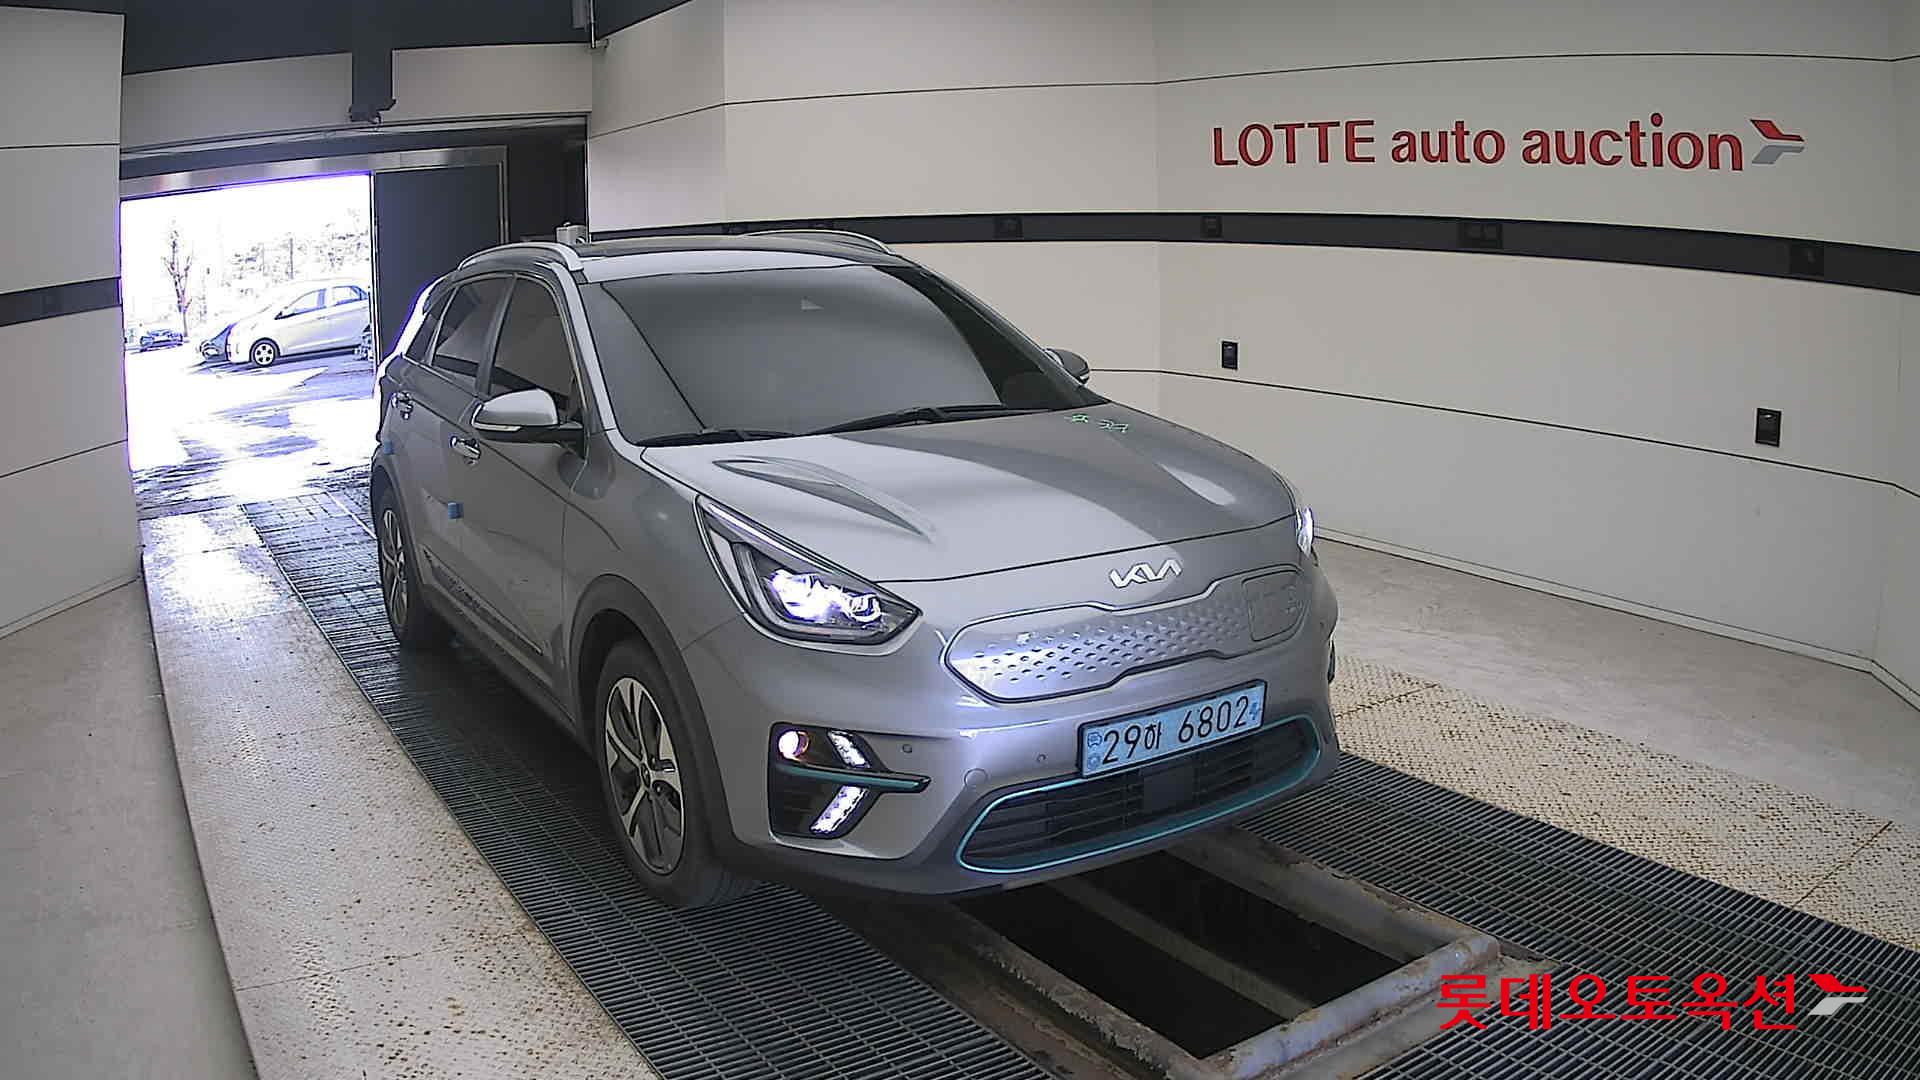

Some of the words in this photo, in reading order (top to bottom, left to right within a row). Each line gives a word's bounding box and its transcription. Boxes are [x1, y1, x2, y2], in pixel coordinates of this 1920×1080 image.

[1212, 119, 1376, 167] LOTTE
[1391, 119, 1506, 165] auto
[1521, 112, 1744, 172] auction
[1102, 721, 1163, 765] 29하
[1178, 695, 1250, 744] 6802
